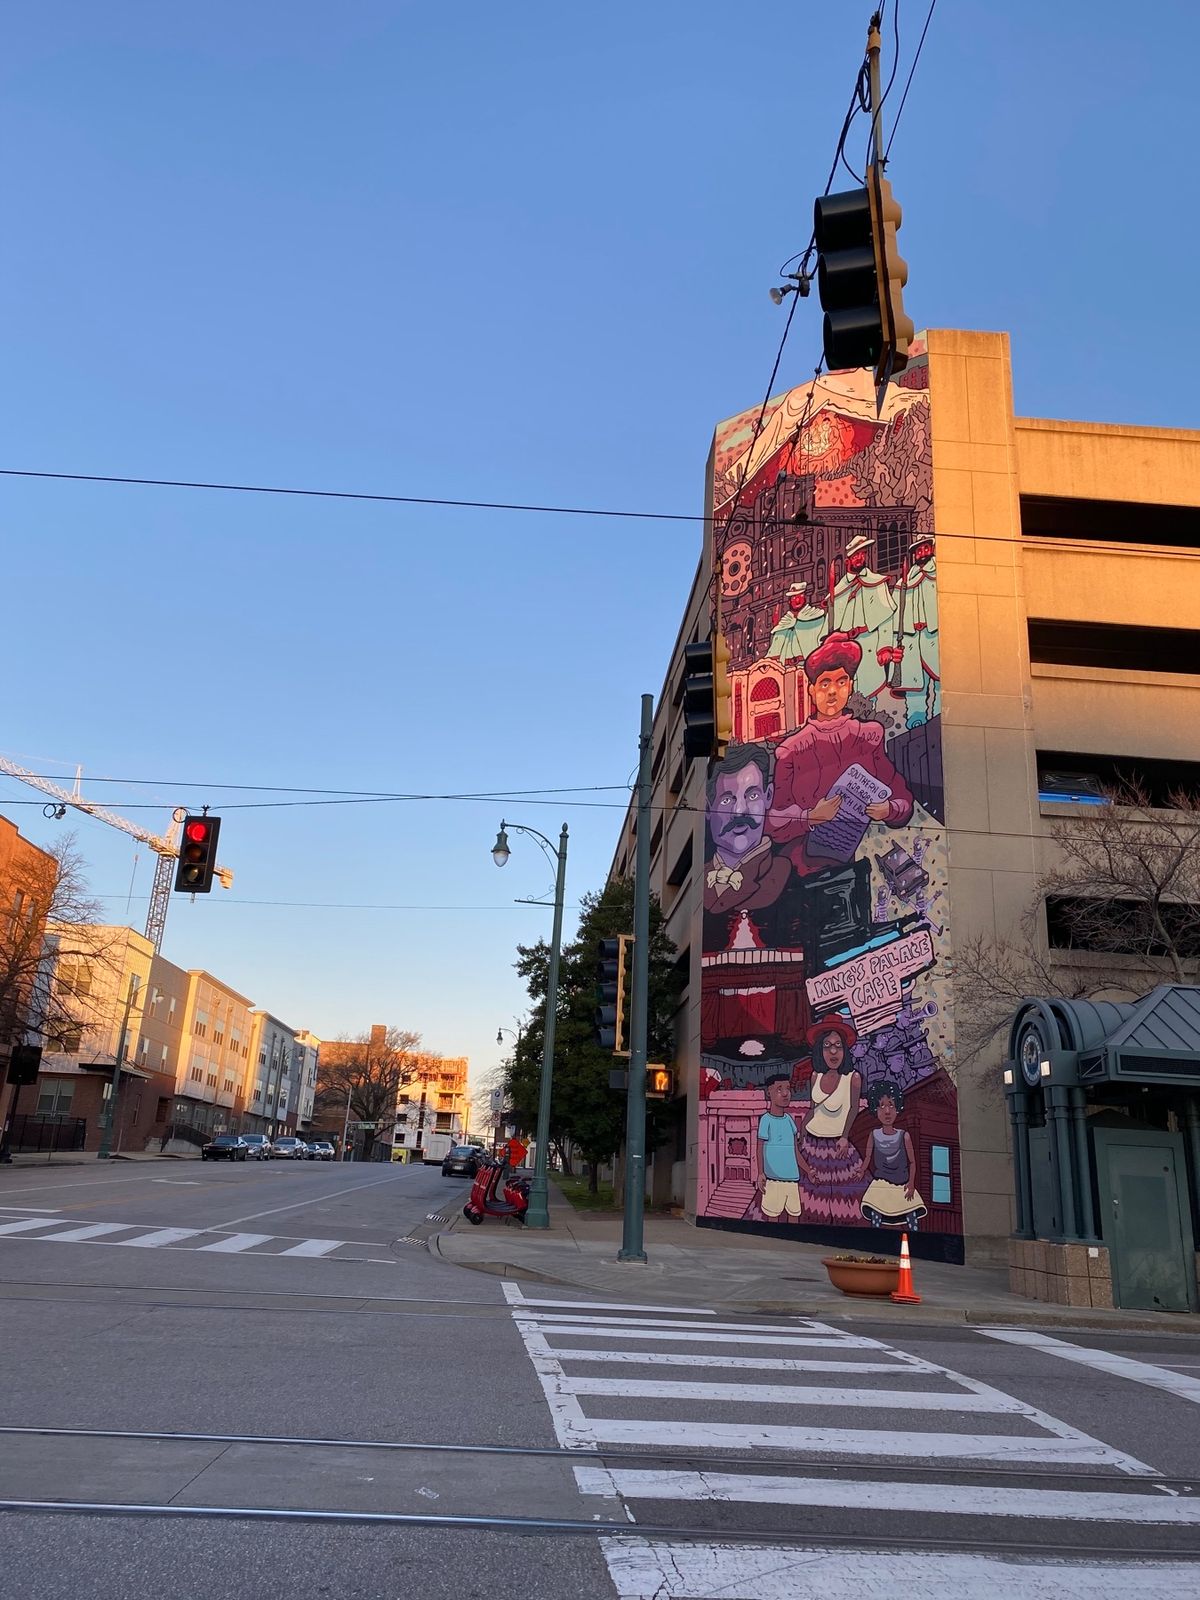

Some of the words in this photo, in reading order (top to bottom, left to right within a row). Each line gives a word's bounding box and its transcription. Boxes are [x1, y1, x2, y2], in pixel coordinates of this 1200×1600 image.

[847, 781, 873, 803] HORRORS
[848, 767, 879, 793] SOUTHERN
[814, 963, 865, 998] KING'S
[869, 938, 930, 974] PALACE
[852, 972, 898, 1008] CAFE
